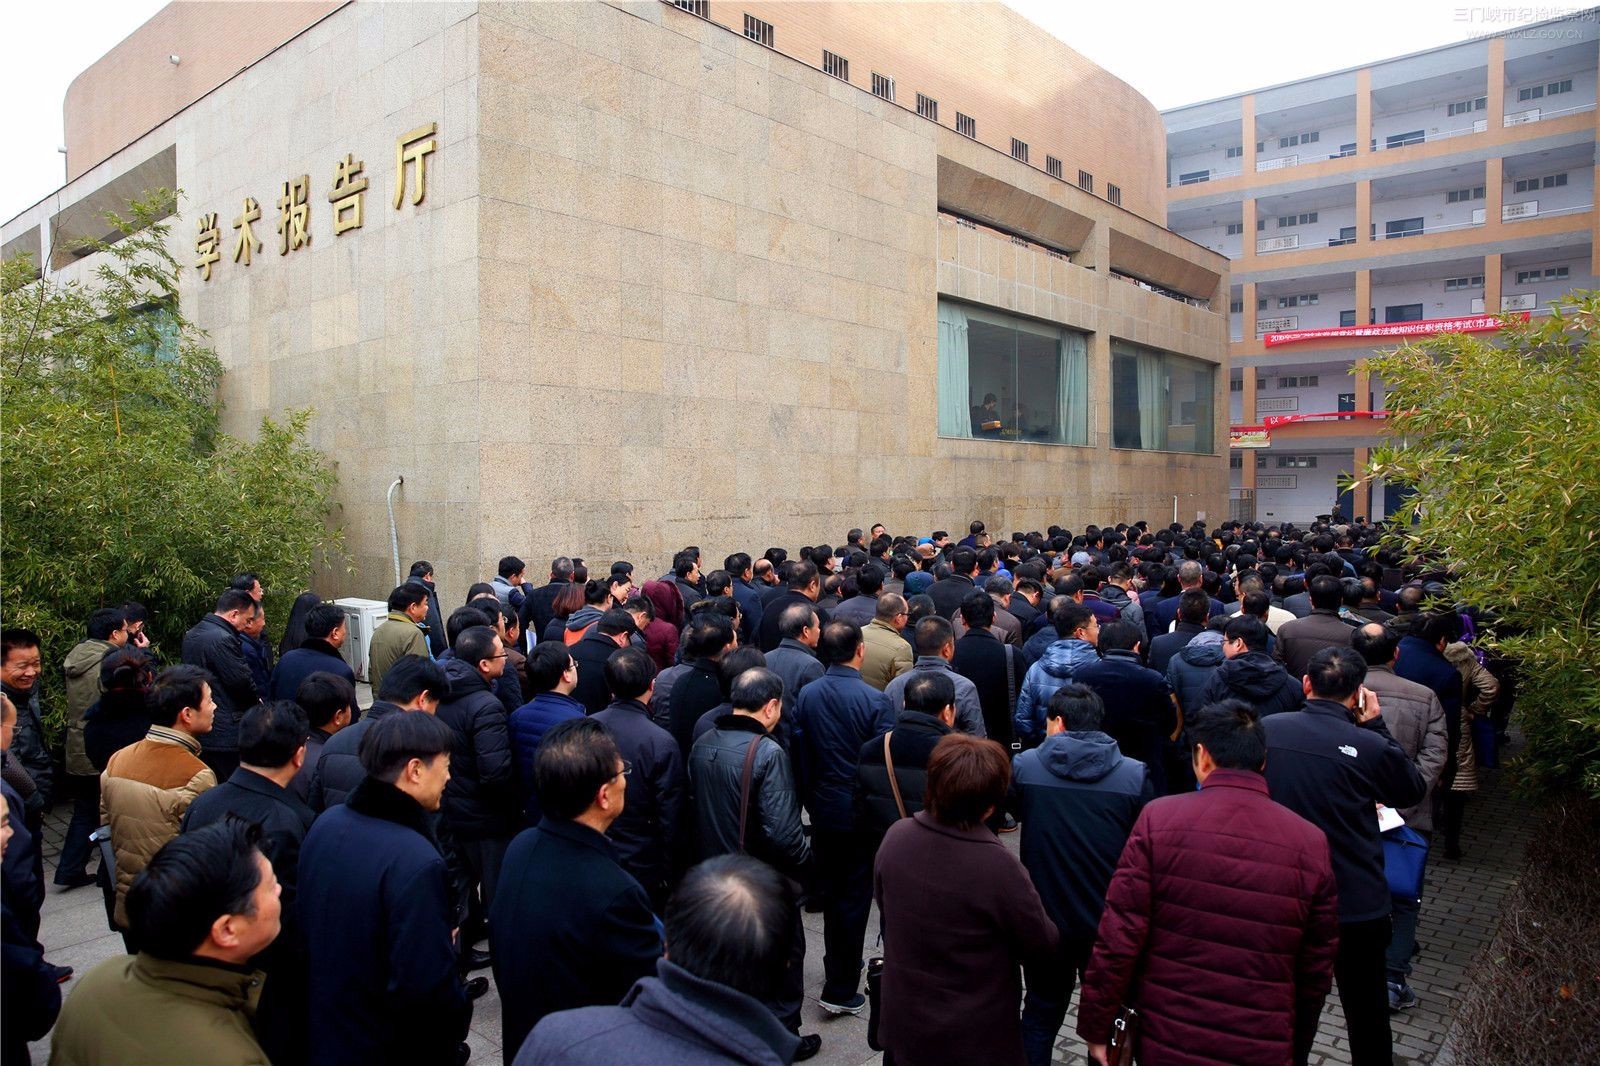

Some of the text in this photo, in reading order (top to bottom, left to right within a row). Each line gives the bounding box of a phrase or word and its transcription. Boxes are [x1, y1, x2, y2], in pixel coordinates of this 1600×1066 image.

[194, 121, 437, 281] 学术报告厅
